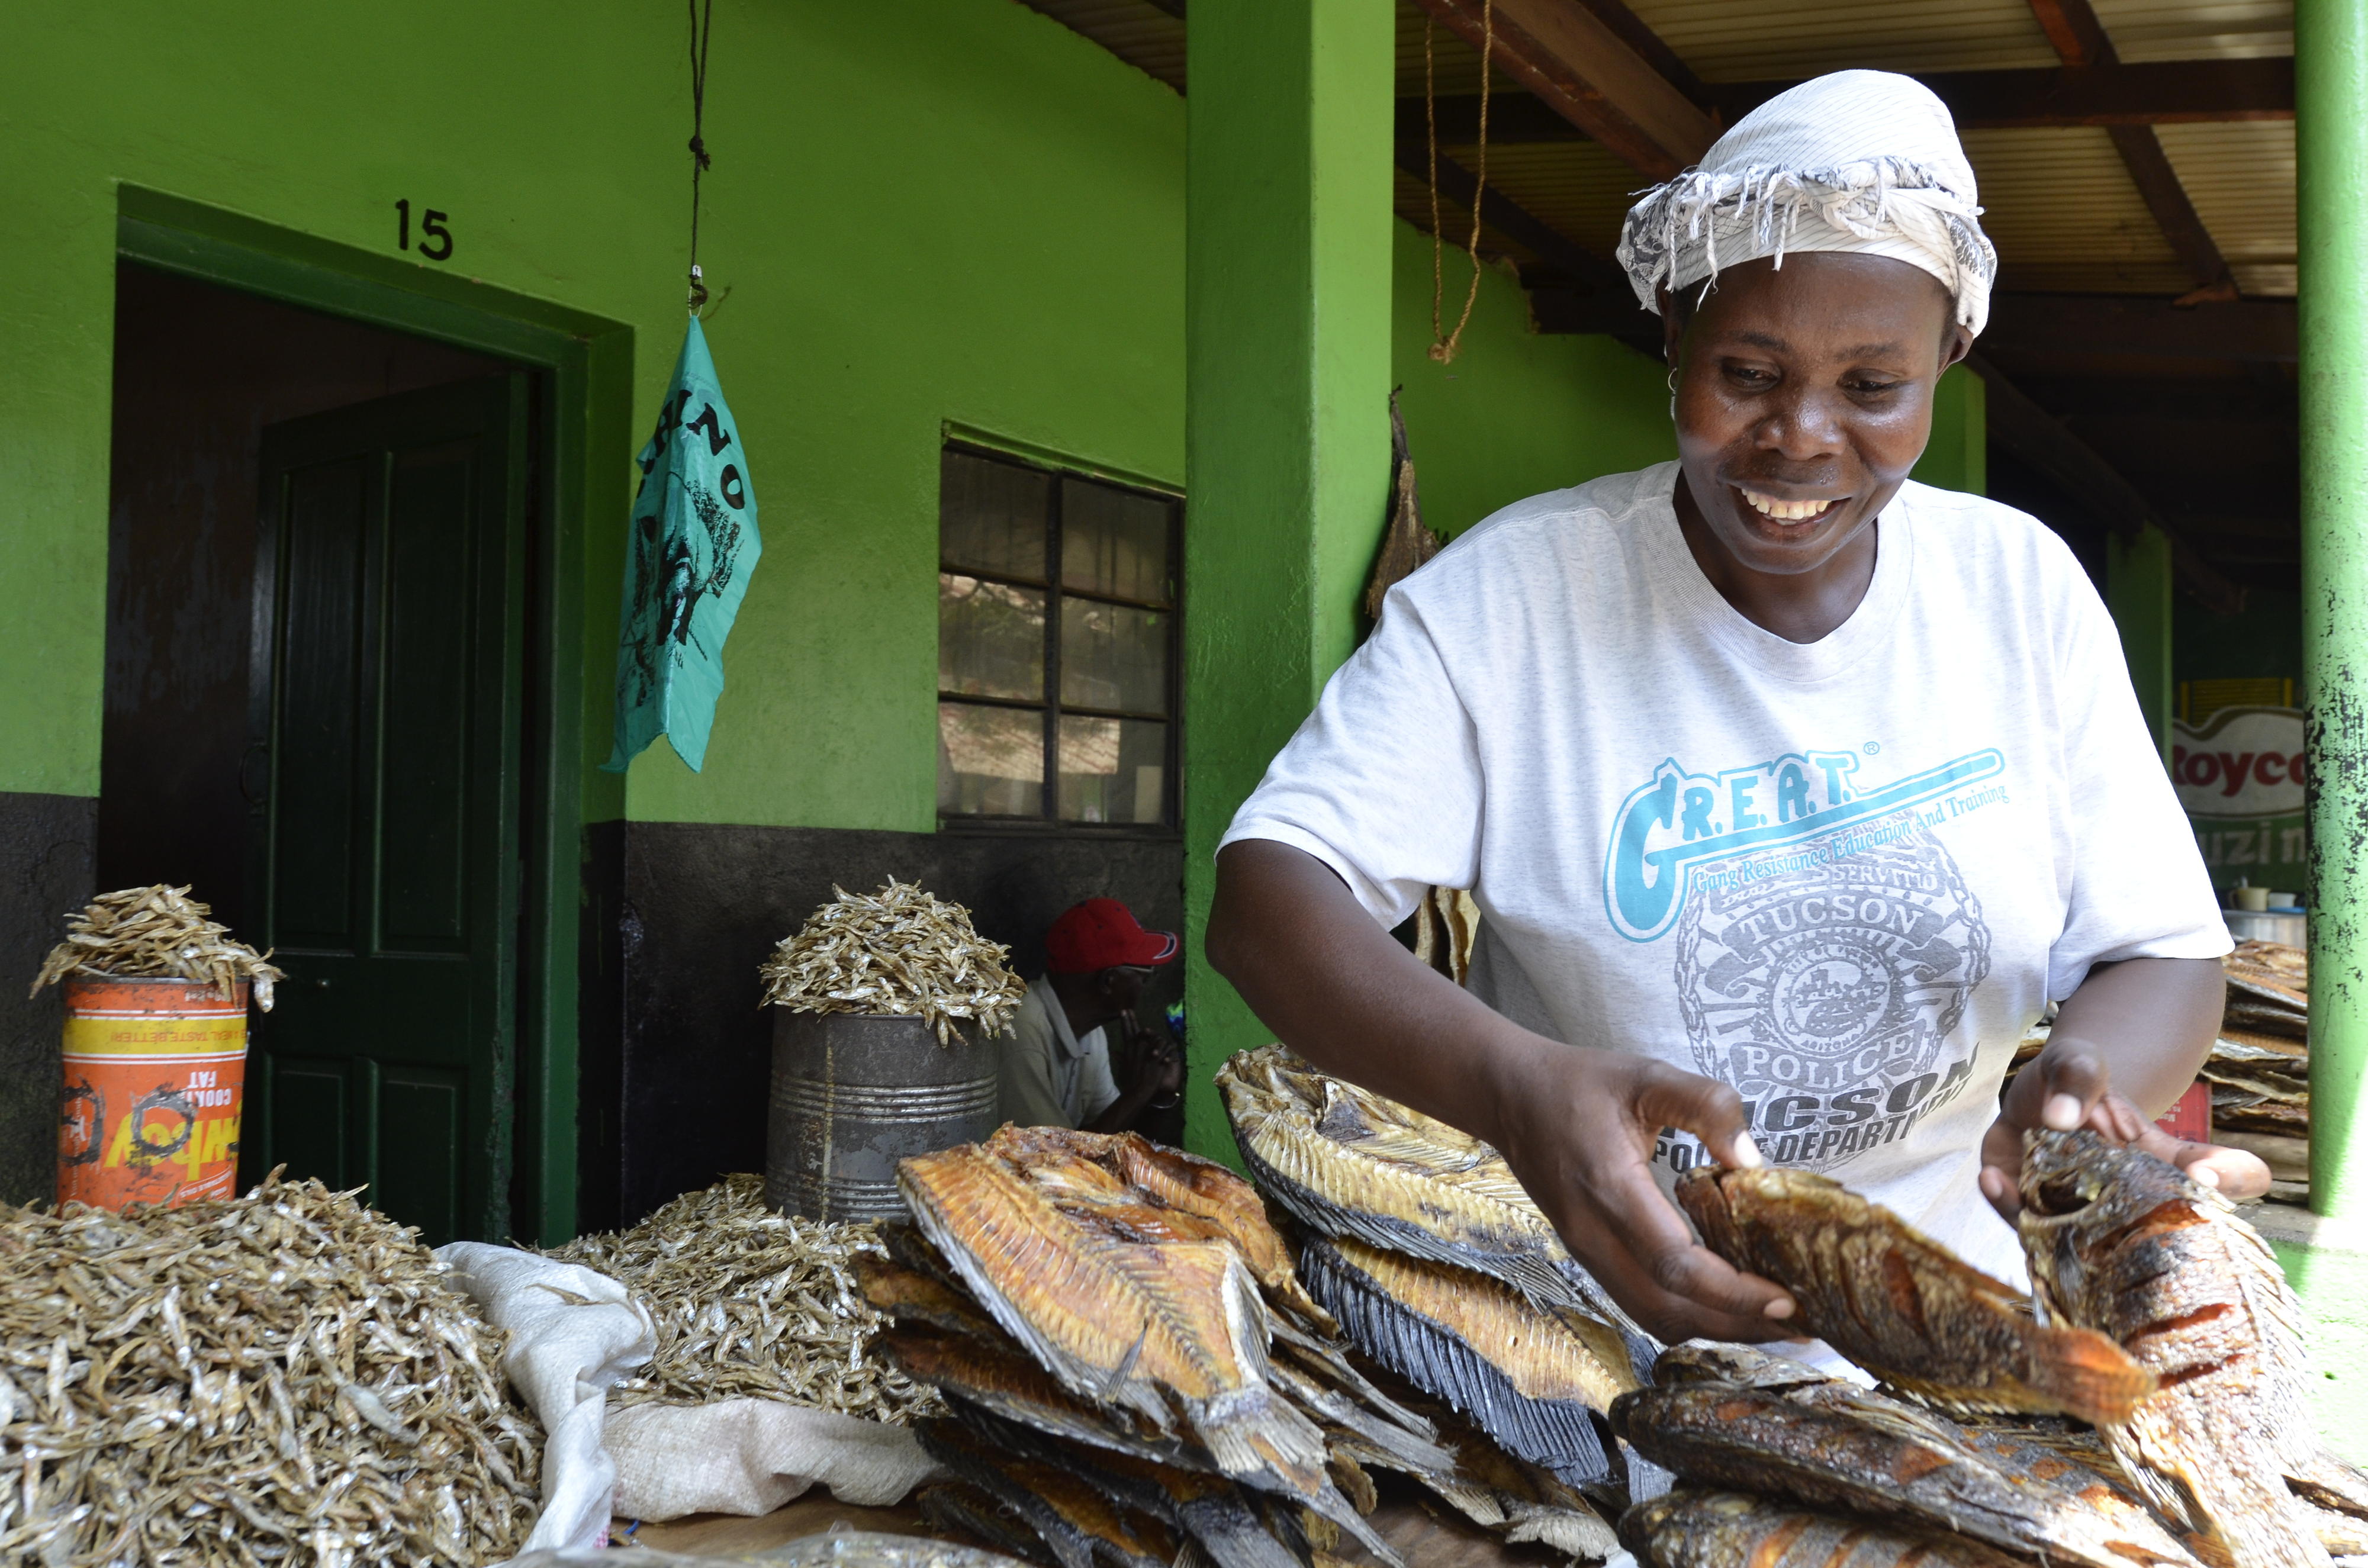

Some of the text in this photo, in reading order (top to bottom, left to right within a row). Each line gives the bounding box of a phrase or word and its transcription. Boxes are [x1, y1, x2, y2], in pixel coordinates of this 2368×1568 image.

[395, 198, 453, 261] 15
[1693, 785, 2010, 894] Gang Resistance Education And Training
[1738, 895, 1924, 945] TUCSON
[187, 1071, 217, 1088] FAT
[1743, 1033, 1916, 1089] POLICE
